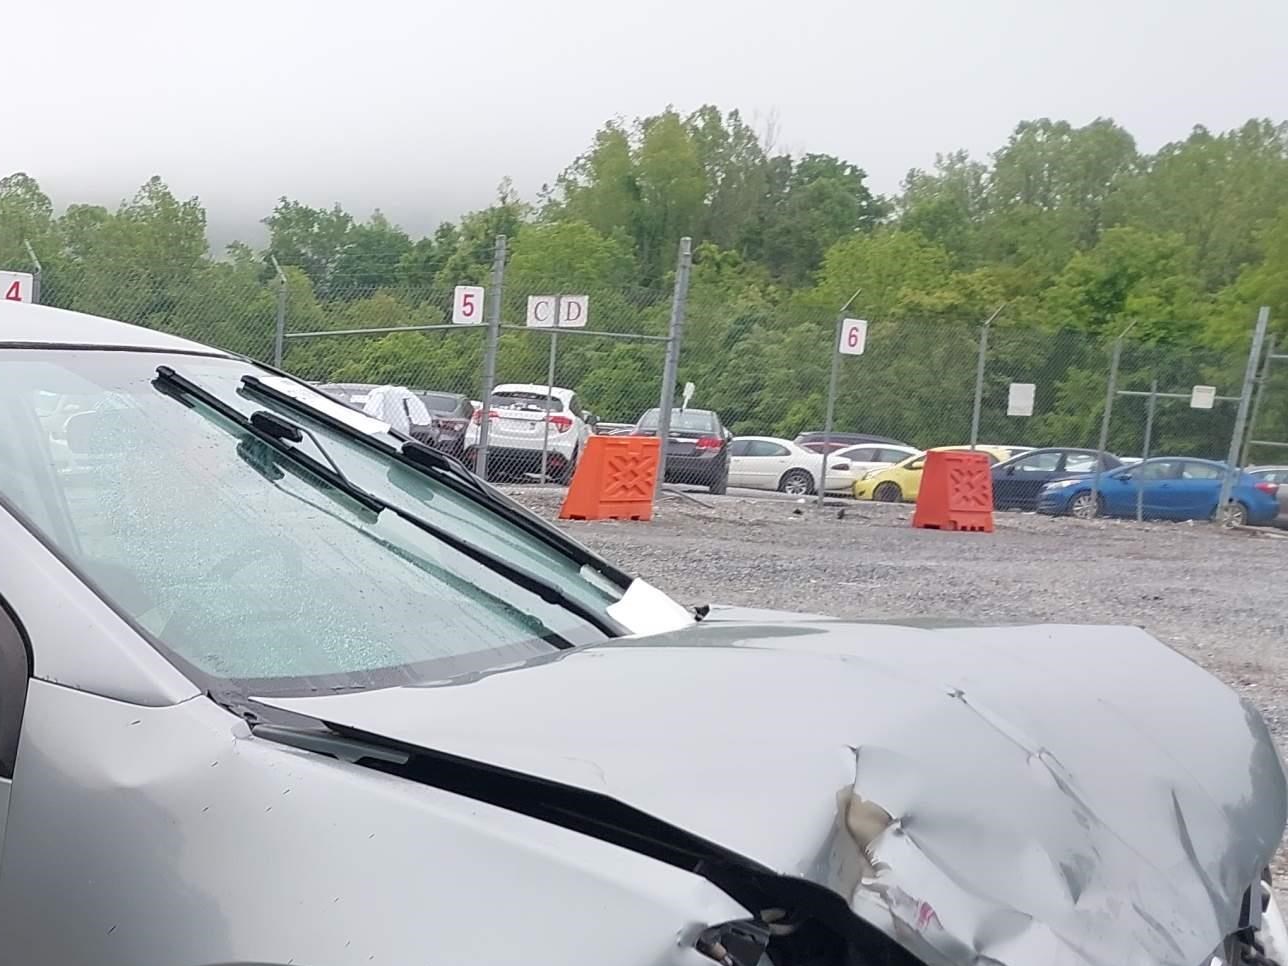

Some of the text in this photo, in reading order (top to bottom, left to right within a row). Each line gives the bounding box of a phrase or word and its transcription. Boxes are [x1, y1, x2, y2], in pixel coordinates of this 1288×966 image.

[5, 281, 22, 302] 4
[462, 294, 474, 317] 5
[534, 301, 549, 321] C
[564, 301, 582, 321] D
[848, 326, 859, 347] 6
